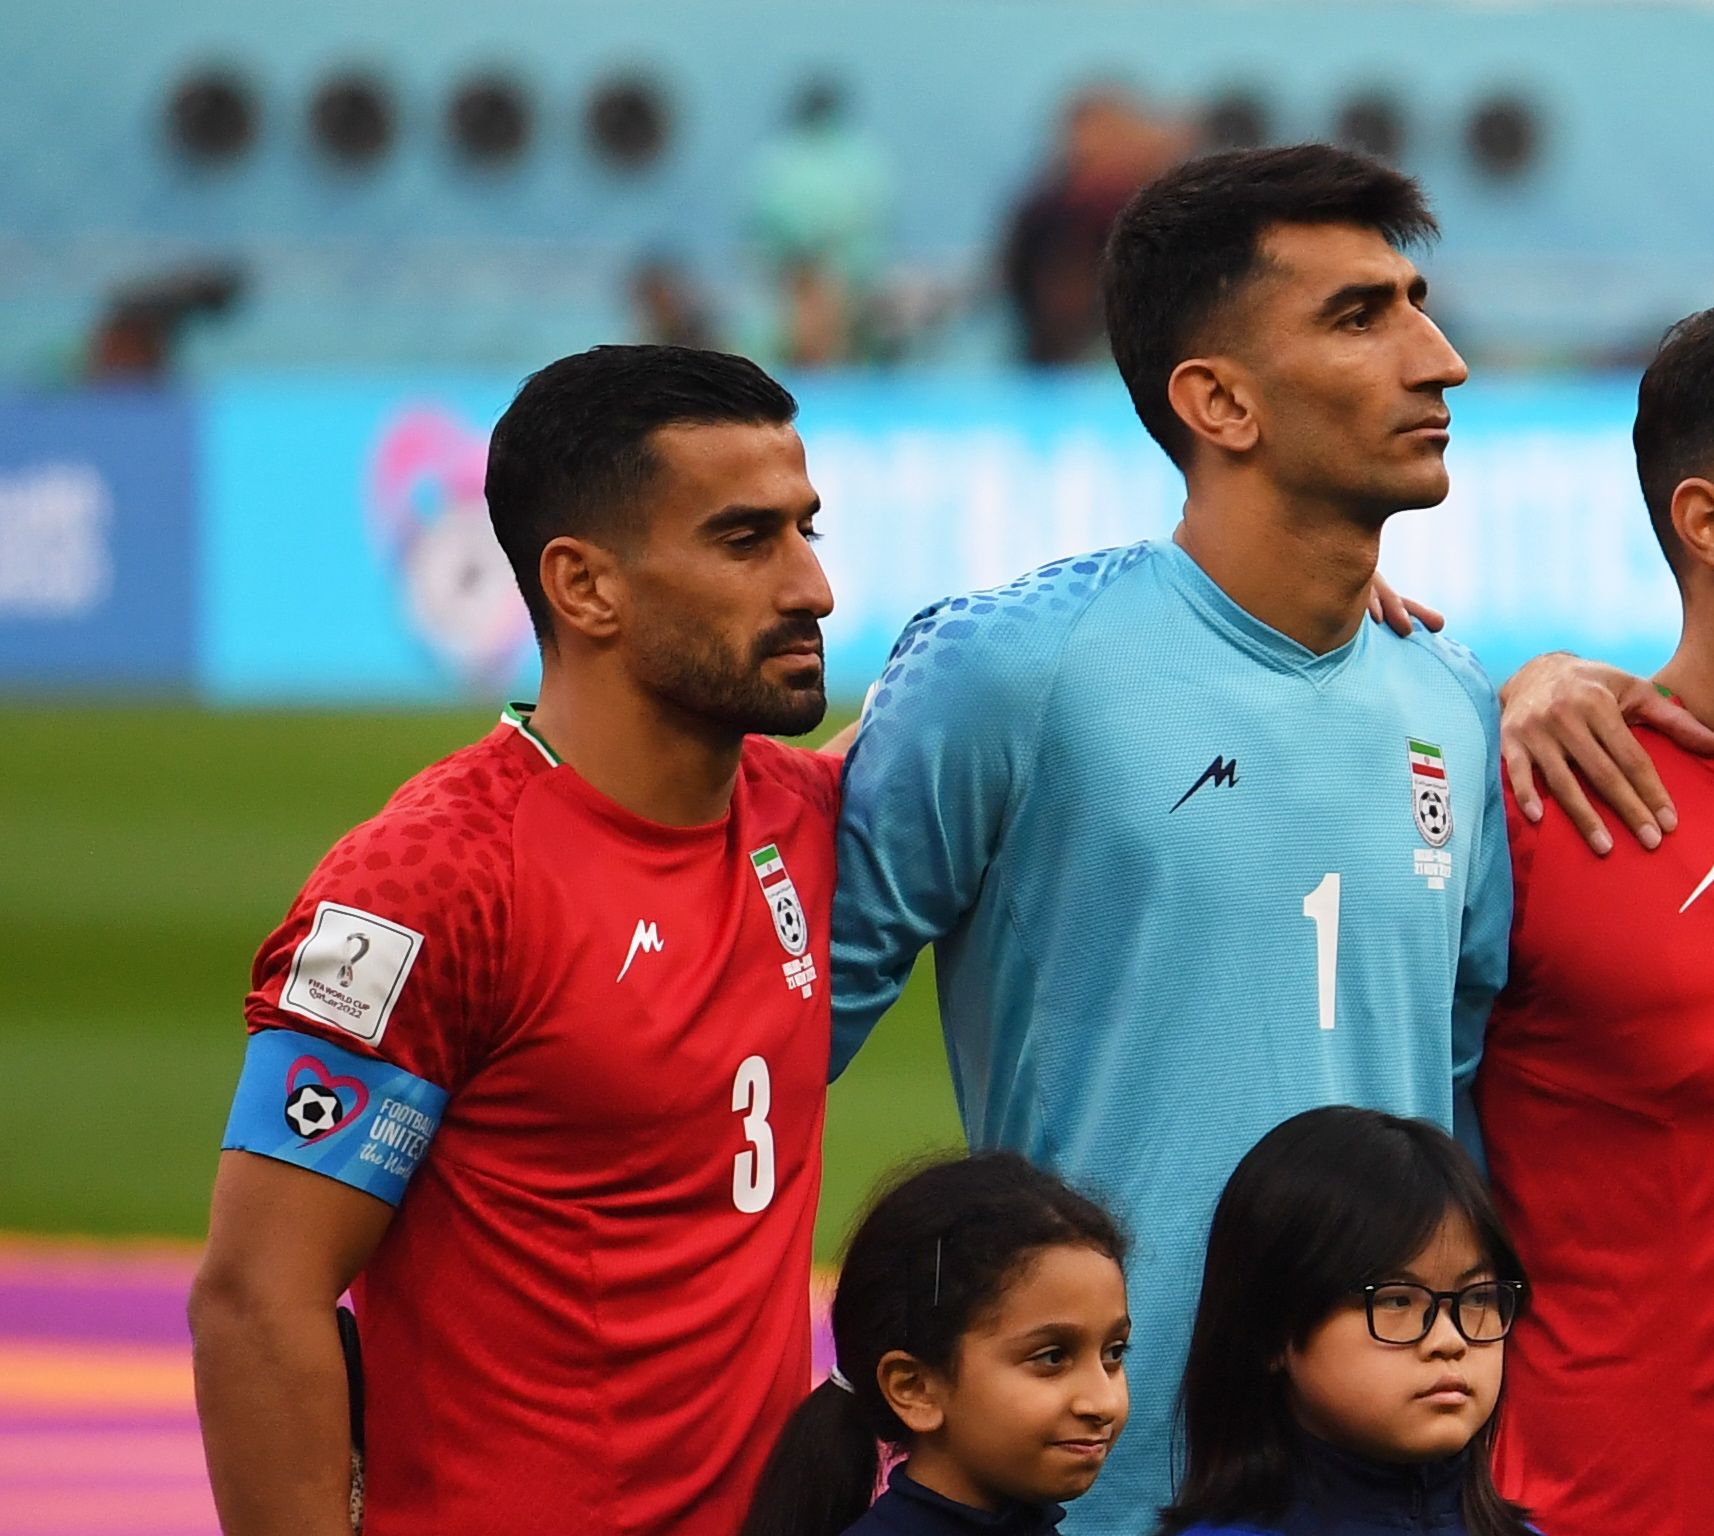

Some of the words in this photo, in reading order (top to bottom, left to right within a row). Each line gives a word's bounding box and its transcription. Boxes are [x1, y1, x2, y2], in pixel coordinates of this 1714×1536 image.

[308, 978, 325, 991] FIFA
[325, 986, 353, 1004] WORLD
[353, 999, 371, 1011] CUP
[1303, 872, 1341, 1030] 1
[359, 1142, 385, 1165] the
[731, 1055, 775, 1214] 3
